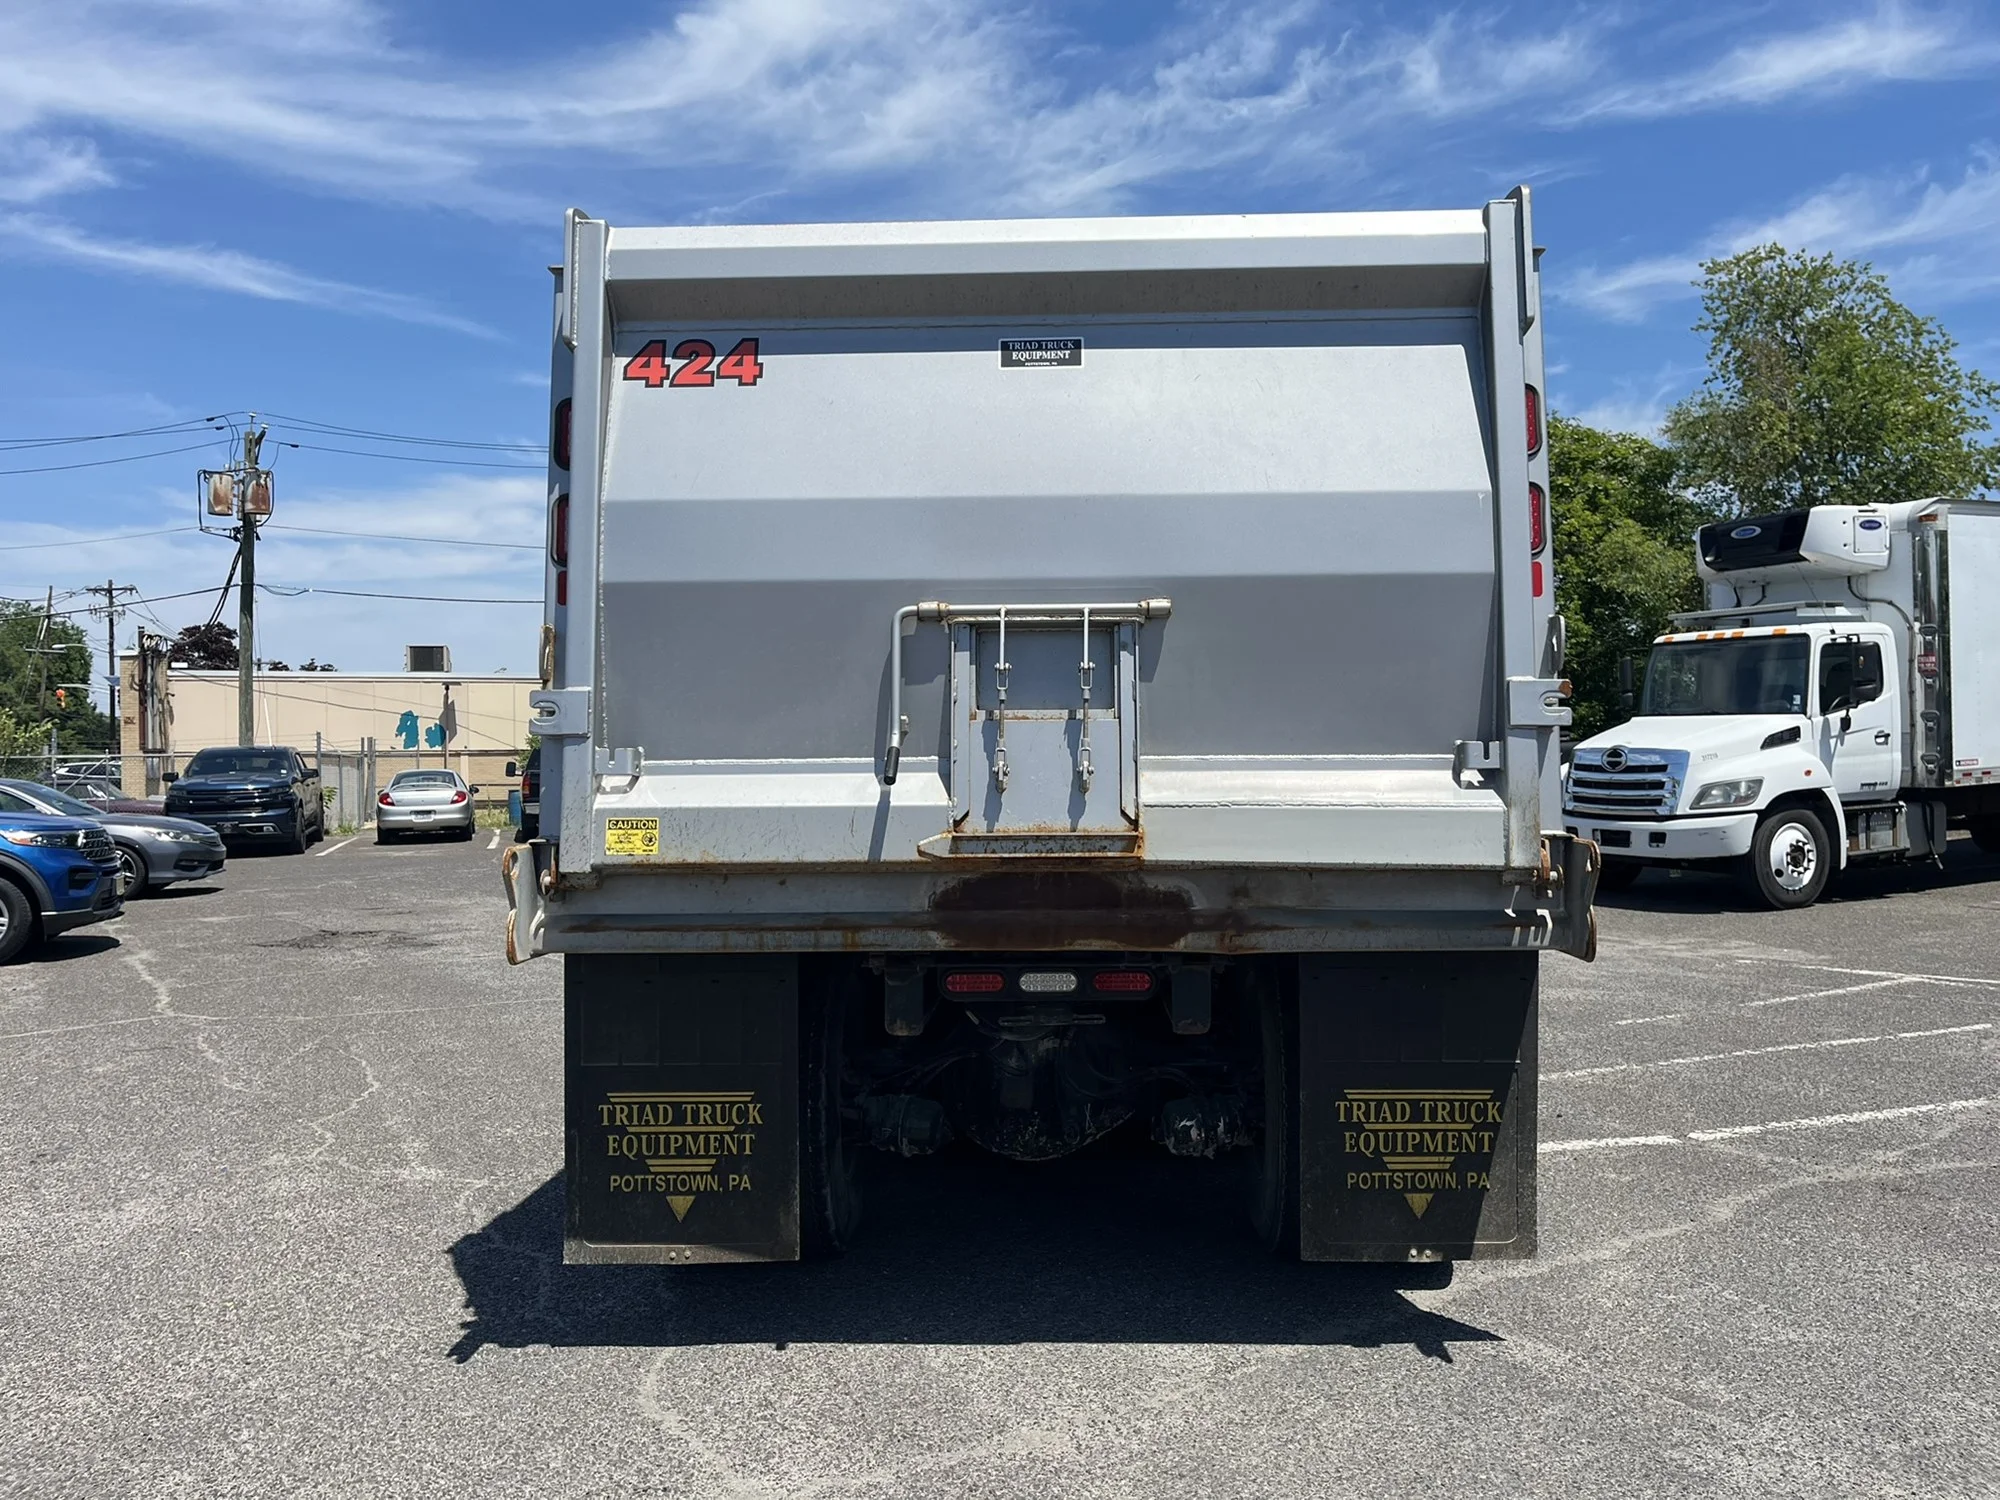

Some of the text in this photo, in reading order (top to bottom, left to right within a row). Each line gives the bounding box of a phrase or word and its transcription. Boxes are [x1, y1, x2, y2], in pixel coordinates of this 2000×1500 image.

[1008, 340, 1074, 350] TRIAD TRUCK
[622, 337, 764, 388] 424
[1012, 350, 1071, 361] EQUIPMENT
[609, 820, 656, 829] CAUTION
[598, 1103, 763, 1126] TRIAD TRUCK
[1335, 1101, 1503, 1123] TRIAD TRUCK
[607, 1134, 755, 1160] EQUIPMENT
[1344, 1131, 1494, 1158] EQUIPMENT
[728, 1174, 752, 1191] PA
[1347, 1172, 1490, 1191] POTTSTOWN, PA
